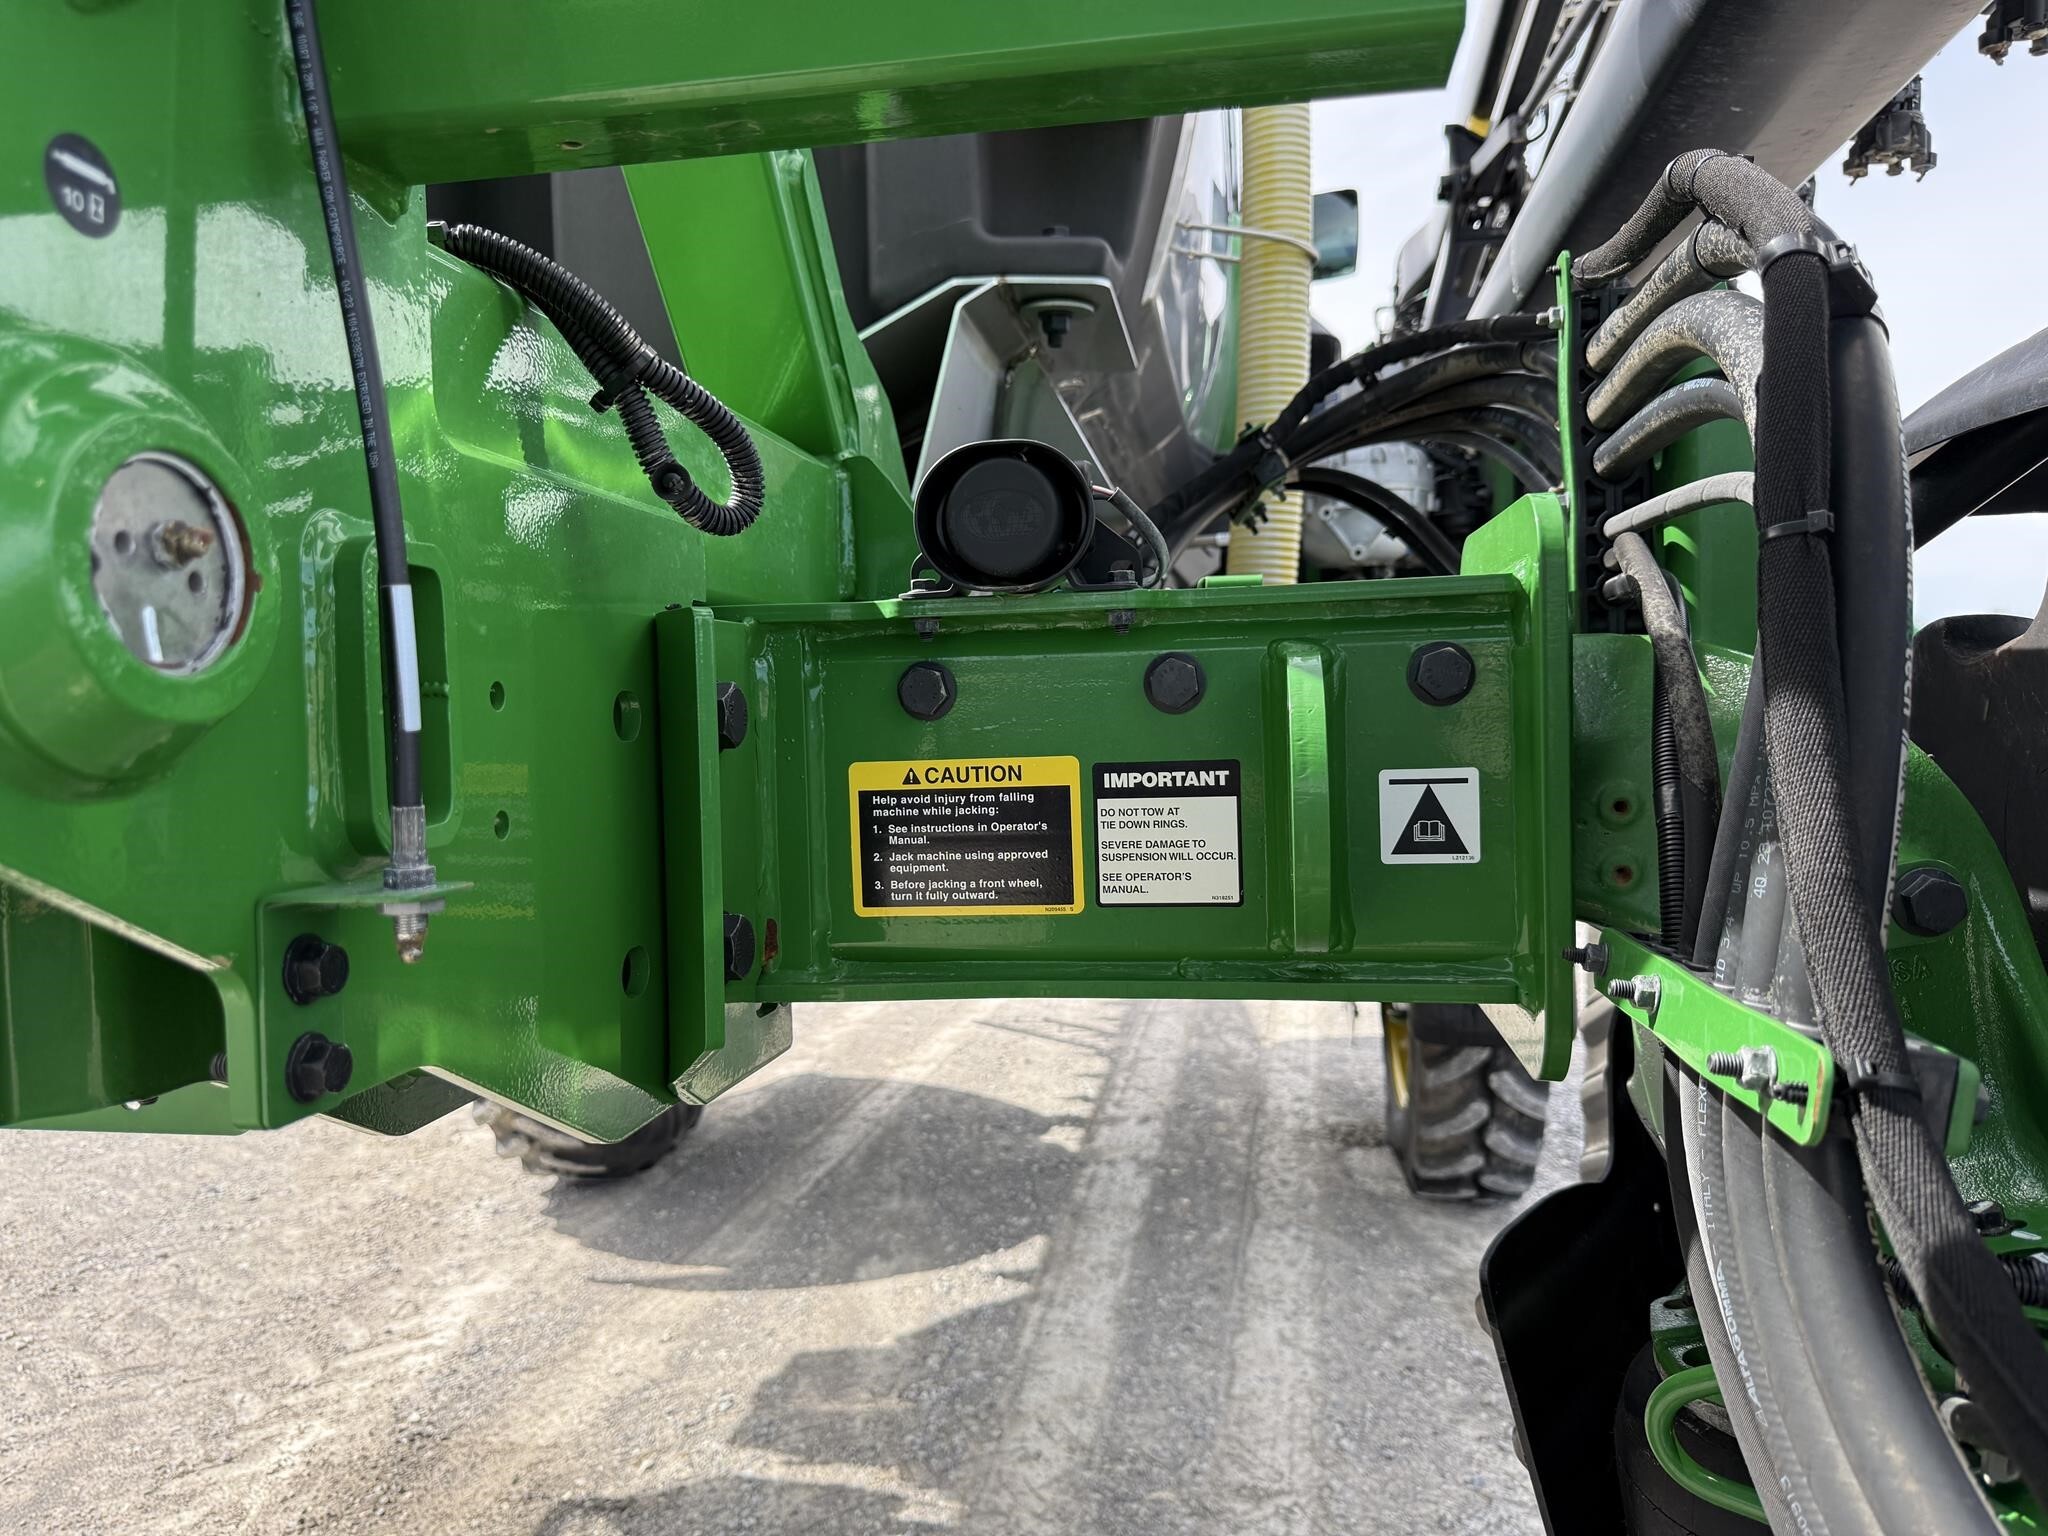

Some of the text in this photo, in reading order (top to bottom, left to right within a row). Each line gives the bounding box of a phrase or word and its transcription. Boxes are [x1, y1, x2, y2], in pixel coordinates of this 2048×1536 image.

[63, 186, 85, 212] 10
[366, 432, 377, 447] THE
[369, 451, 380, 468] USA
[924, 764, 1022, 784] CAUTION
[1103, 770, 1230, 788] IMPORTANT
[872, 792, 1034, 806] Help avoid injury from falling
[873, 805, 999, 817] machine while jacking:
[1100, 807, 1180, 817] DO NOT TOW AT
[872, 821, 1048, 833] 1. See instructions in Operator's
[1100, 819, 1188, 829] TIE DOWN RINGS.
[889, 835, 930, 844] Manual.
[1101, 839, 1206, 849] SEVERE DAMAGE TO
[873, 849, 1048, 861] 2. Jack machine using approved
[1101, 851, 1237, 862] SUSPENSION WILL OCCUR.
[889, 863, 949, 874] equipment.
[1102, 872, 1192, 881] SEE OPERATOR'S
[1716, 958, 1726, 981] ID
[1731, 872, 1743, 894] WP
[1749, 775, 1761, 807] MPa
[874, 880, 884, 889] 3.
[890, 880, 925, 889] Before
[928, 880, 967, 891] jacking
[979, 878, 1005, 888] front
[1008, 878, 1043, 888] wheel,
[1102, 885, 1149, 893] MANUAL.
[891, 890, 999, 902] turn it fully outward.
[1701, 1172, 1716, 1231] ITALY
[1716, 1259, 1762, 1409] ALFAGOMMA
